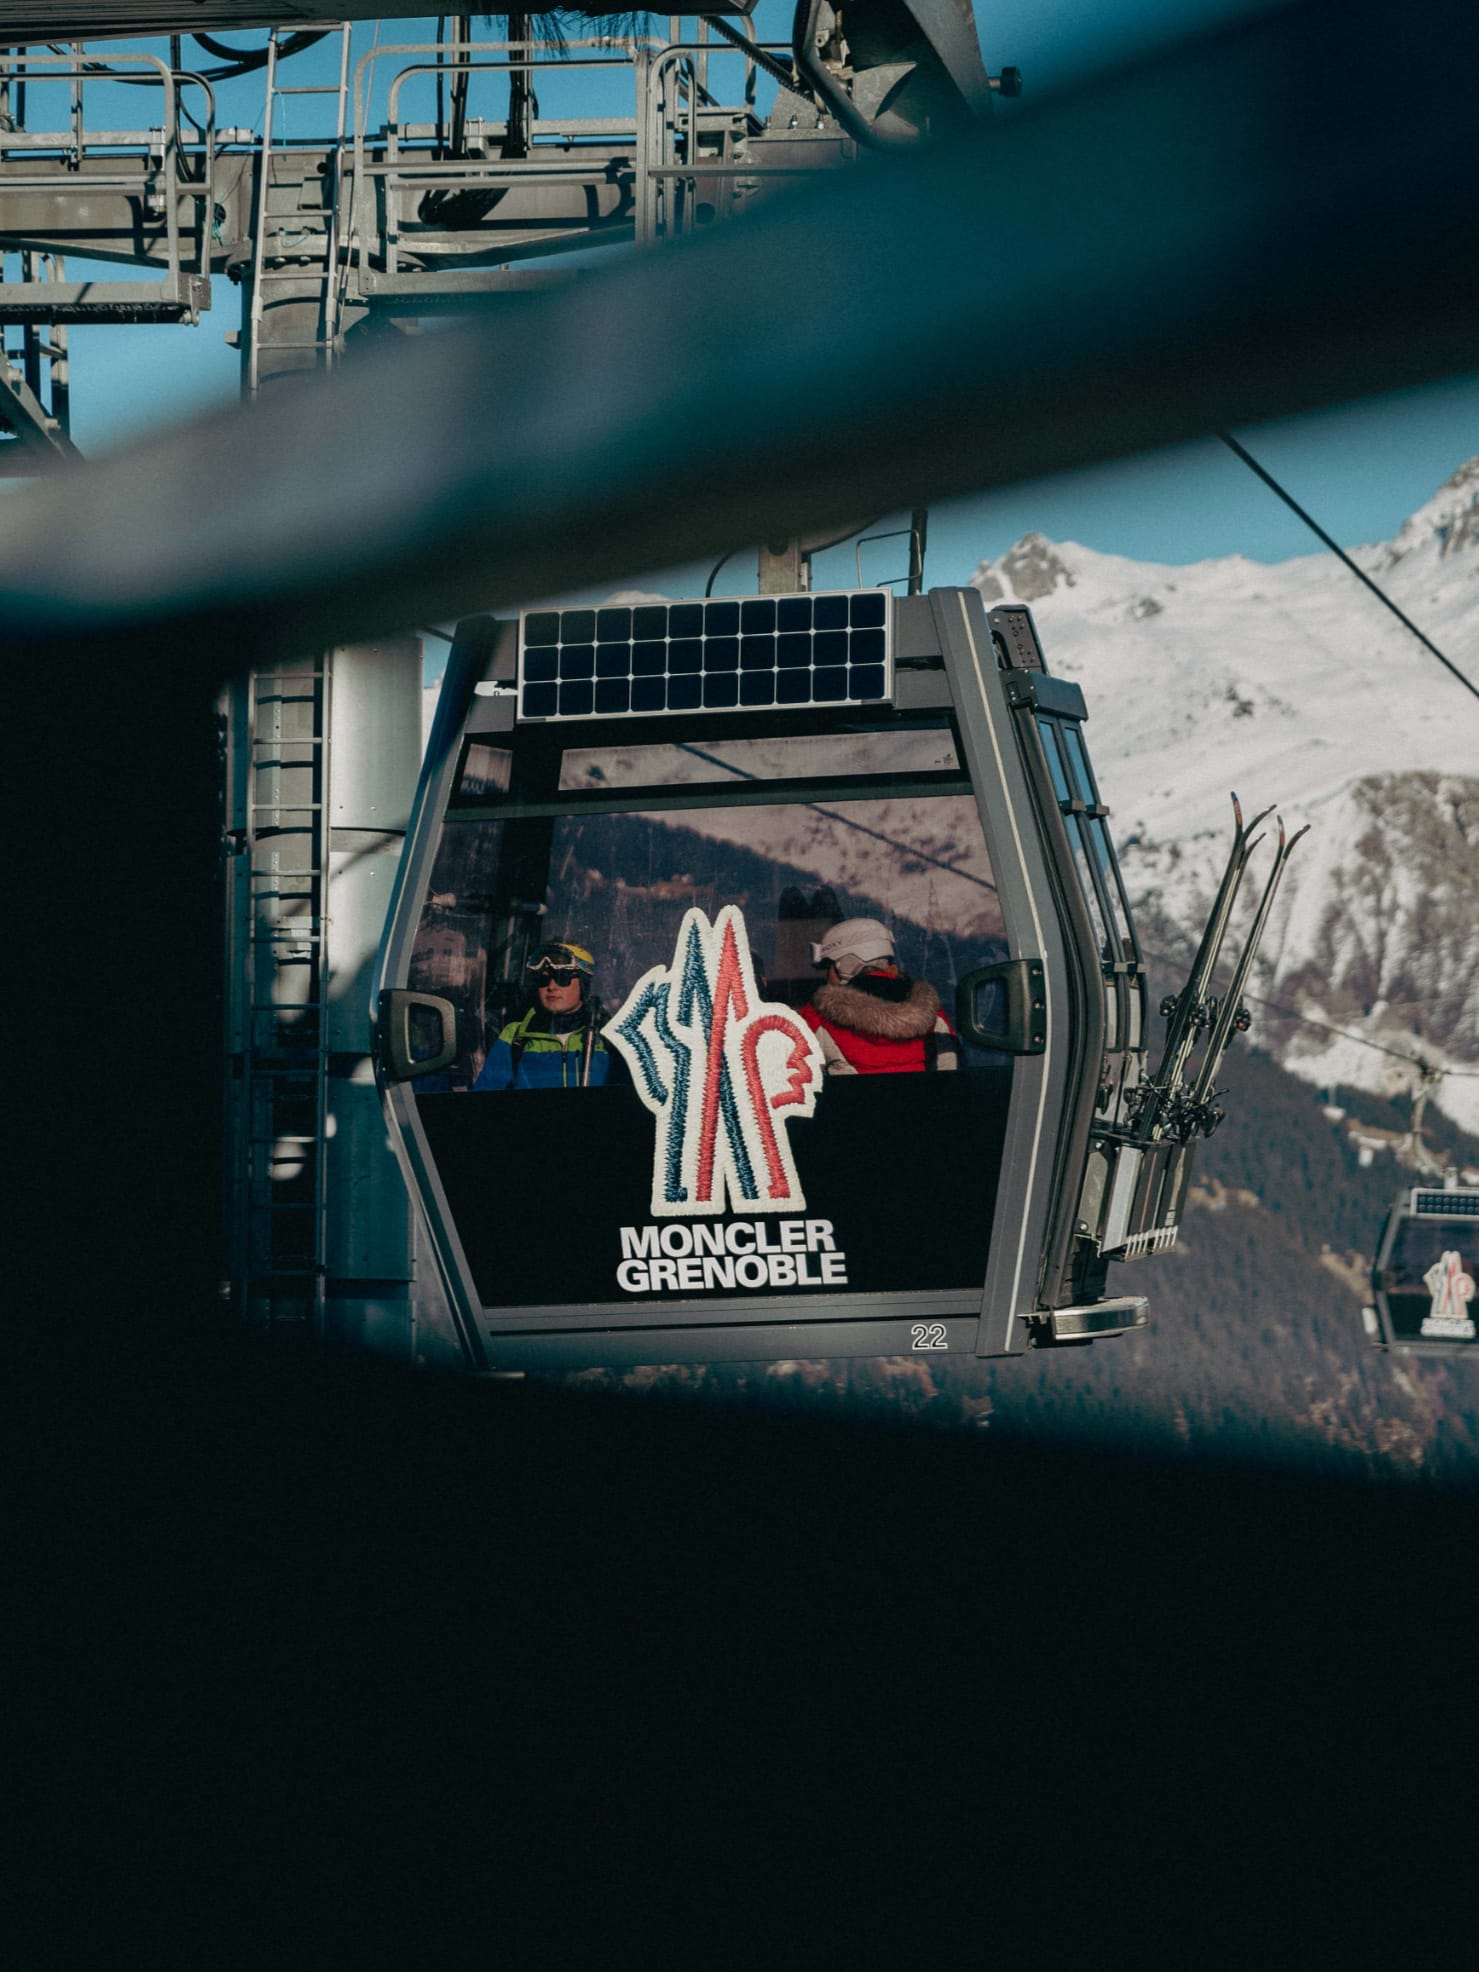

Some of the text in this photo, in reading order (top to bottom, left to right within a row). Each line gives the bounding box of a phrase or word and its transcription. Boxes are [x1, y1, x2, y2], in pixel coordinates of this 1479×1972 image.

[620, 1219, 836, 1258] MONCLER
[616, 1252, 848, 1292] GRENOBLE
[911, 1323, 948, 1350] 22
